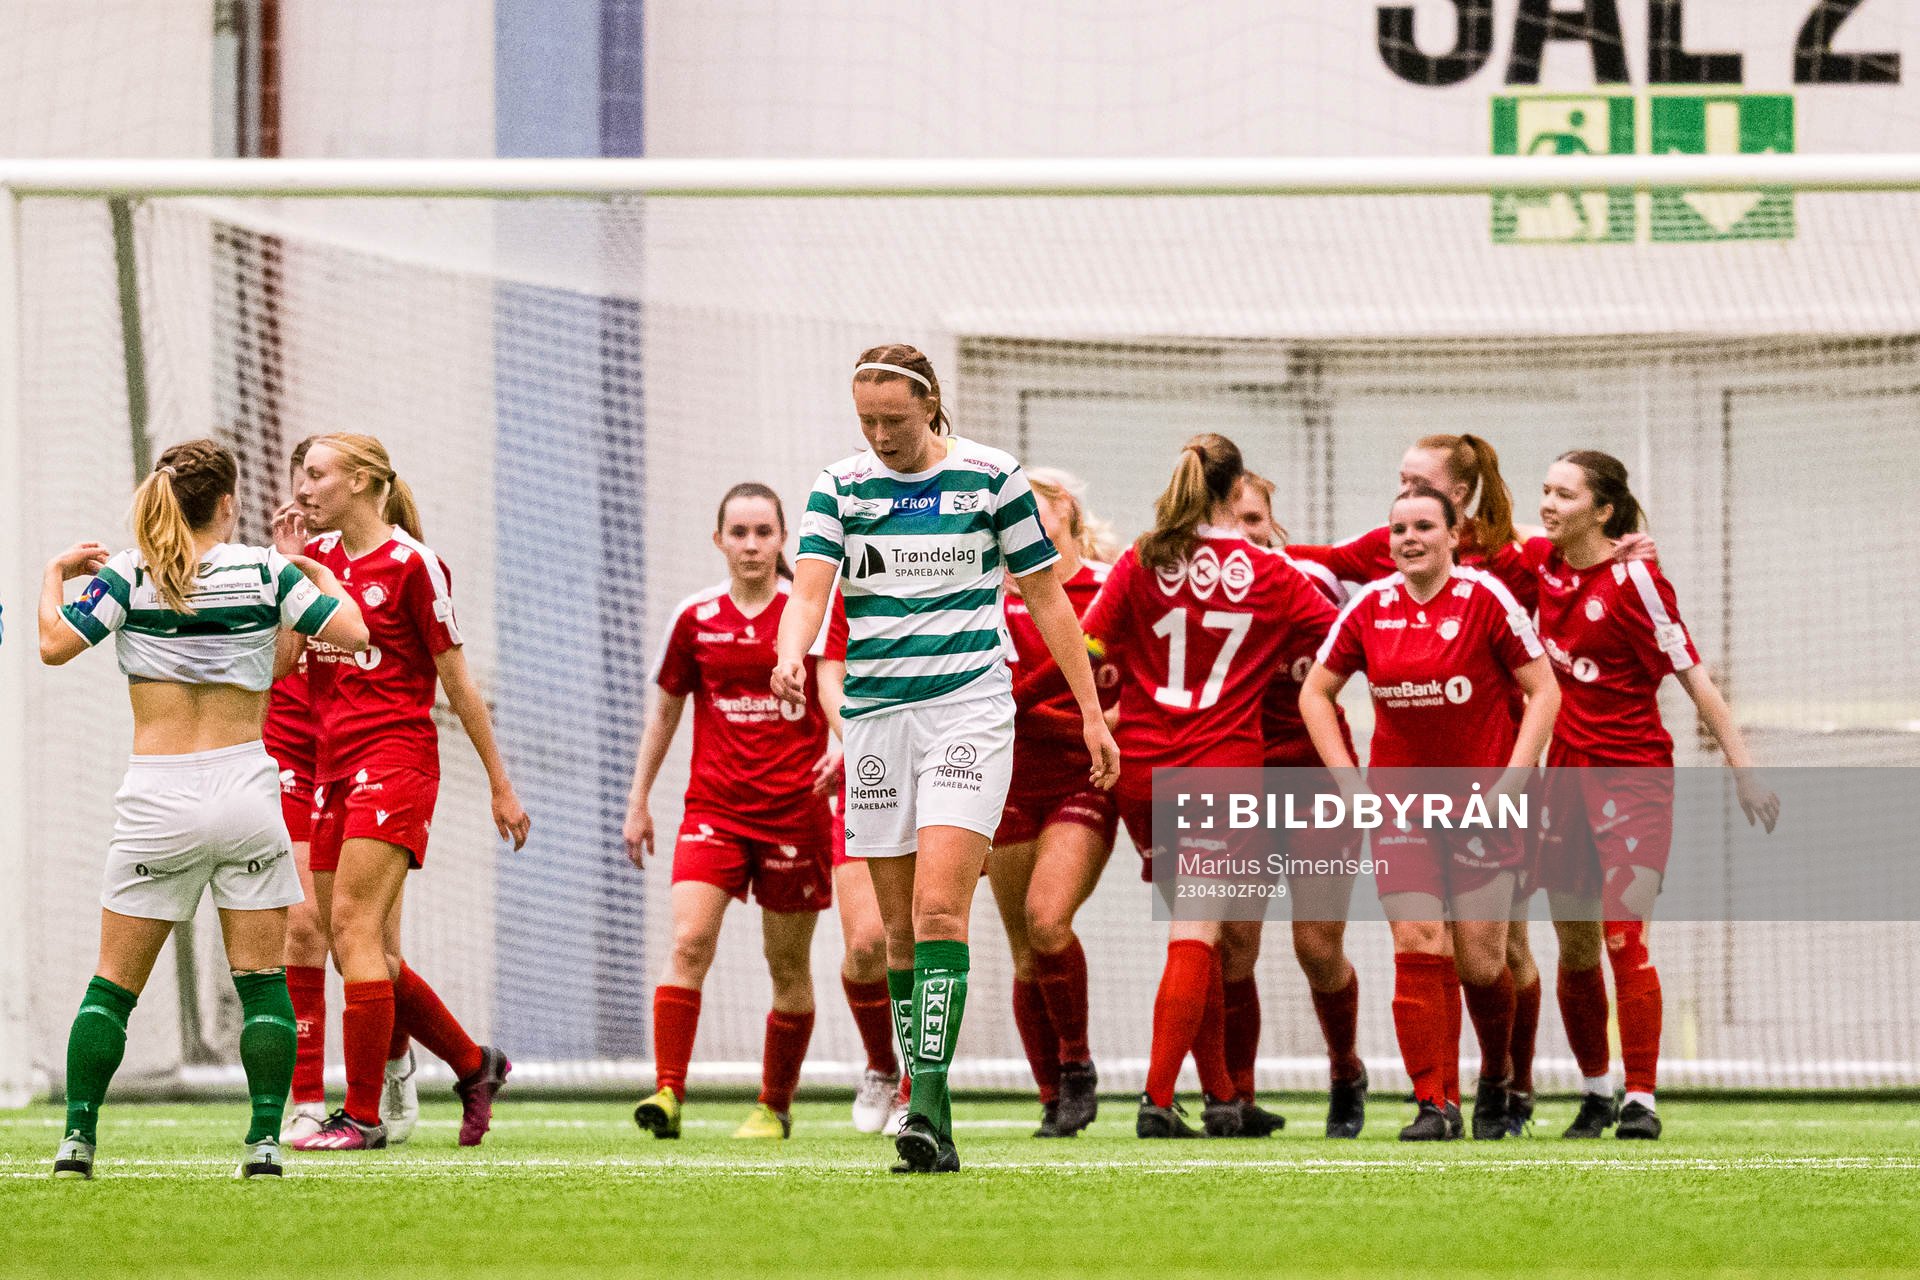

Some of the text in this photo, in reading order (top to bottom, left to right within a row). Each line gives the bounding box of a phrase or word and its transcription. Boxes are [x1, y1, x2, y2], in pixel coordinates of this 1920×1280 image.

[891, 547, 976, 565] Trøndelag
[895, 568, 955, 577] SPAREBANK
[1152, 607, 1254, 709] 17
[935, 765, 983, 782] Hemne
[850, 786, 897, 799] Hemne
[932, 780, 981, 793] SPAREBANK
[851, 801, 898, 810] SPAREBANK
